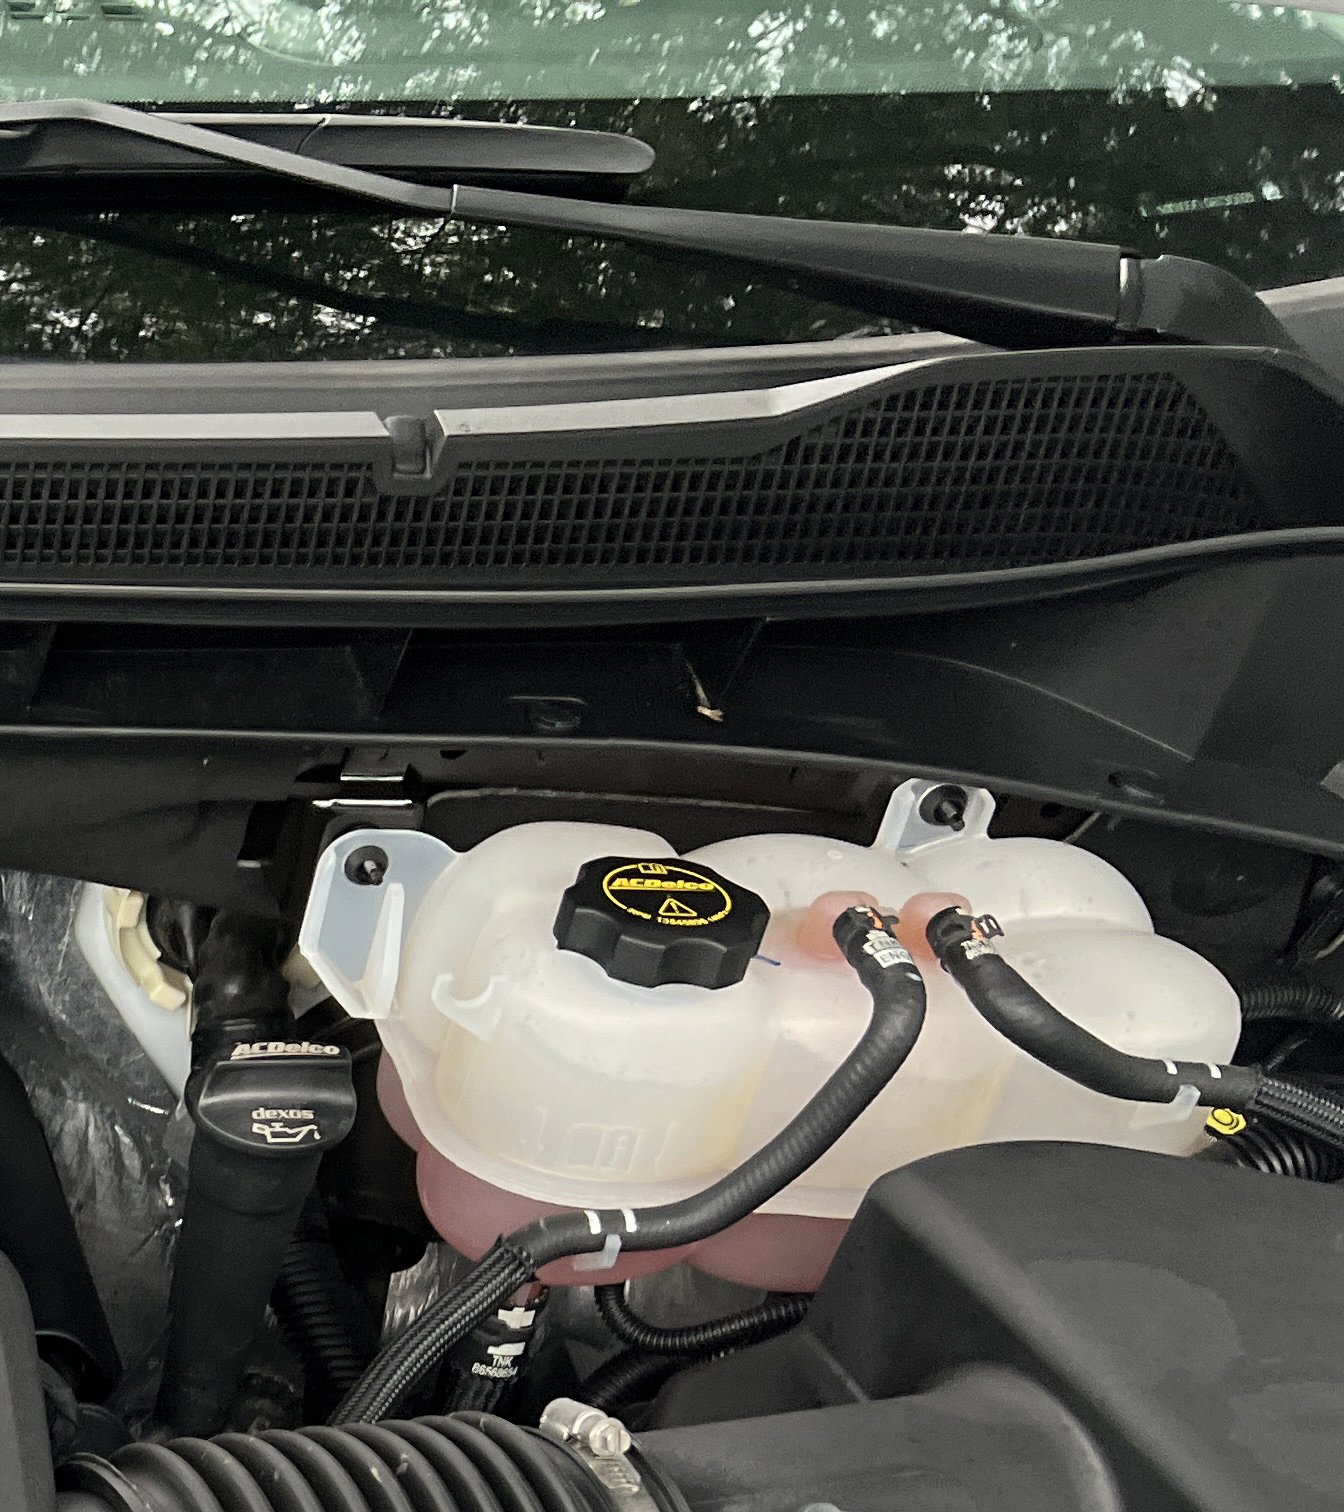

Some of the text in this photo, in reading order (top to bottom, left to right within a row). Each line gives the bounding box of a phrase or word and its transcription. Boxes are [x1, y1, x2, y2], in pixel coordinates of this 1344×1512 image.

[611, 877, 715, 891] ACDelco
[231, 1041, 341, 1057] ACDelco
[252, 1107, 315, 1120] dexos
